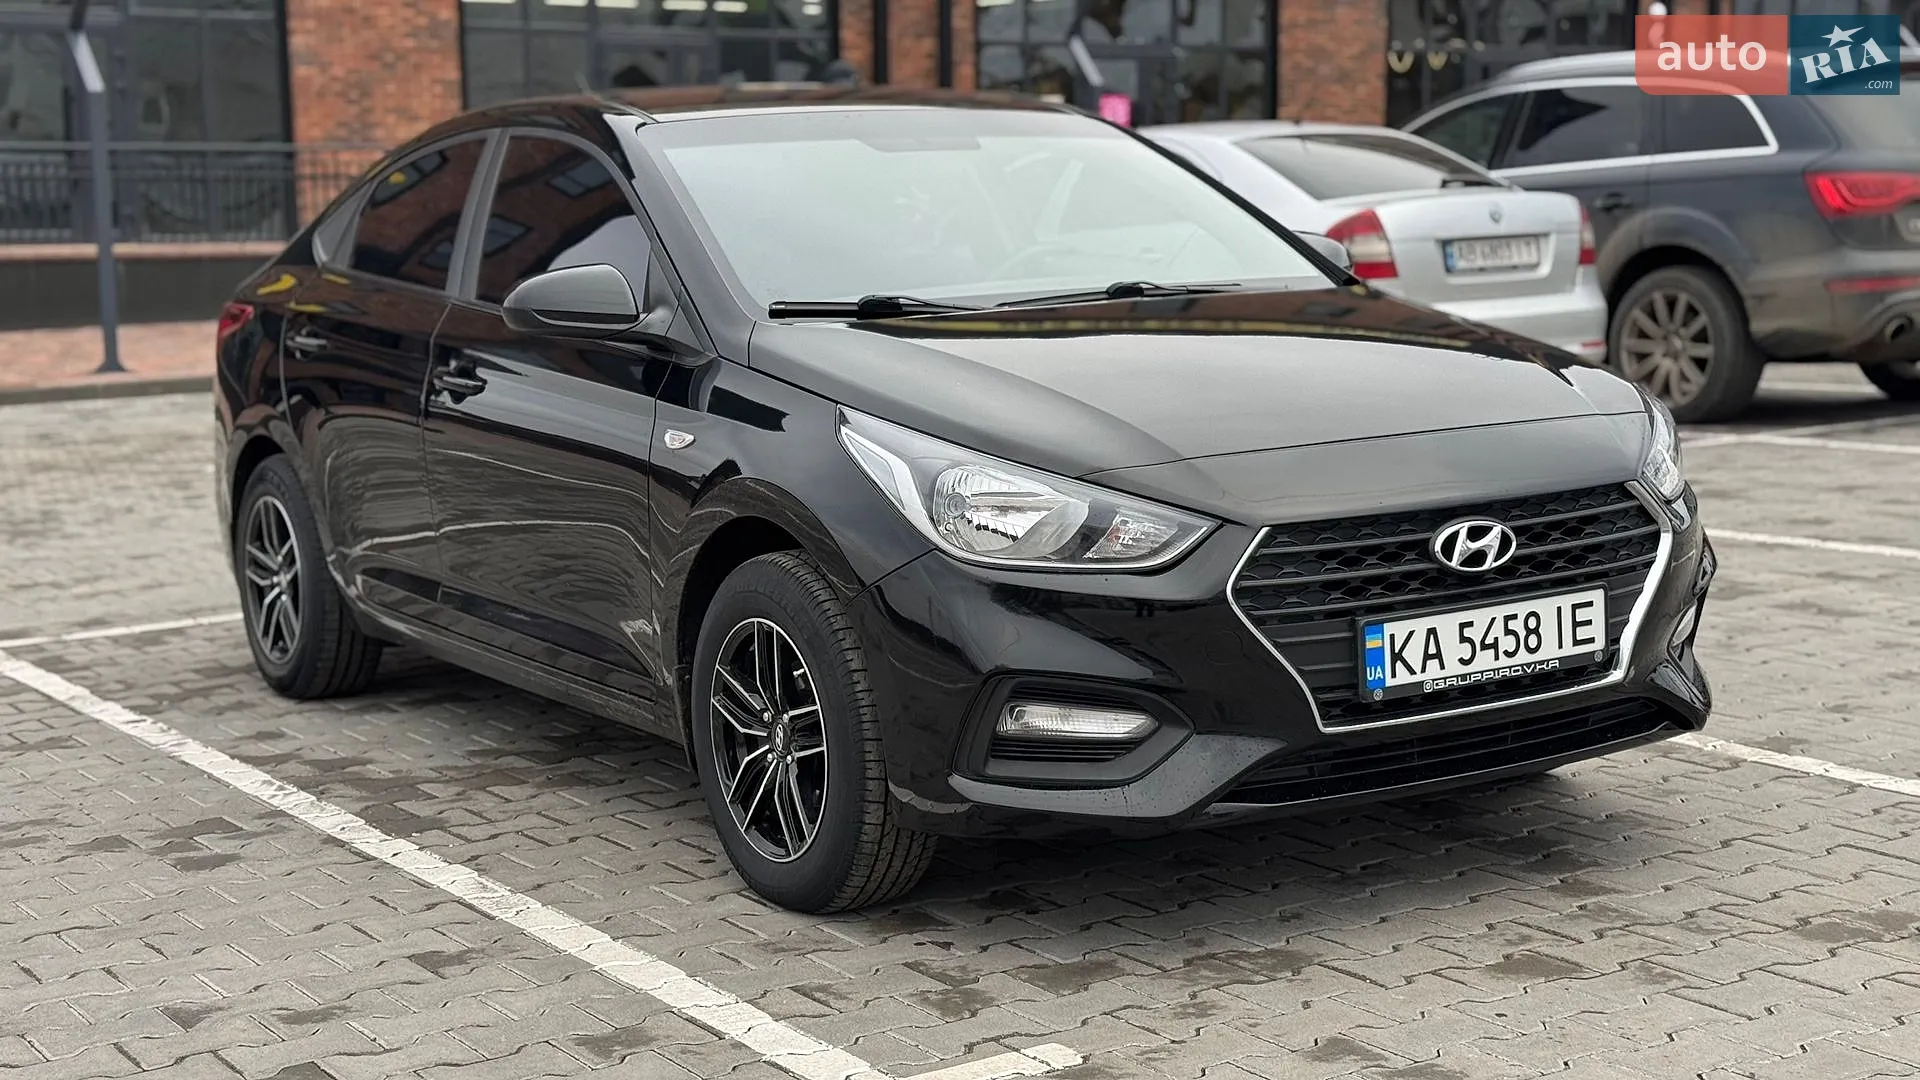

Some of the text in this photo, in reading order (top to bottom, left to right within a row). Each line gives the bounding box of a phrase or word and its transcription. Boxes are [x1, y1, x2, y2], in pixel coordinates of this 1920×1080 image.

[1389, 600, 1596, 679] KA 5458 IE
[1366, 665, 1384, 680] UA
